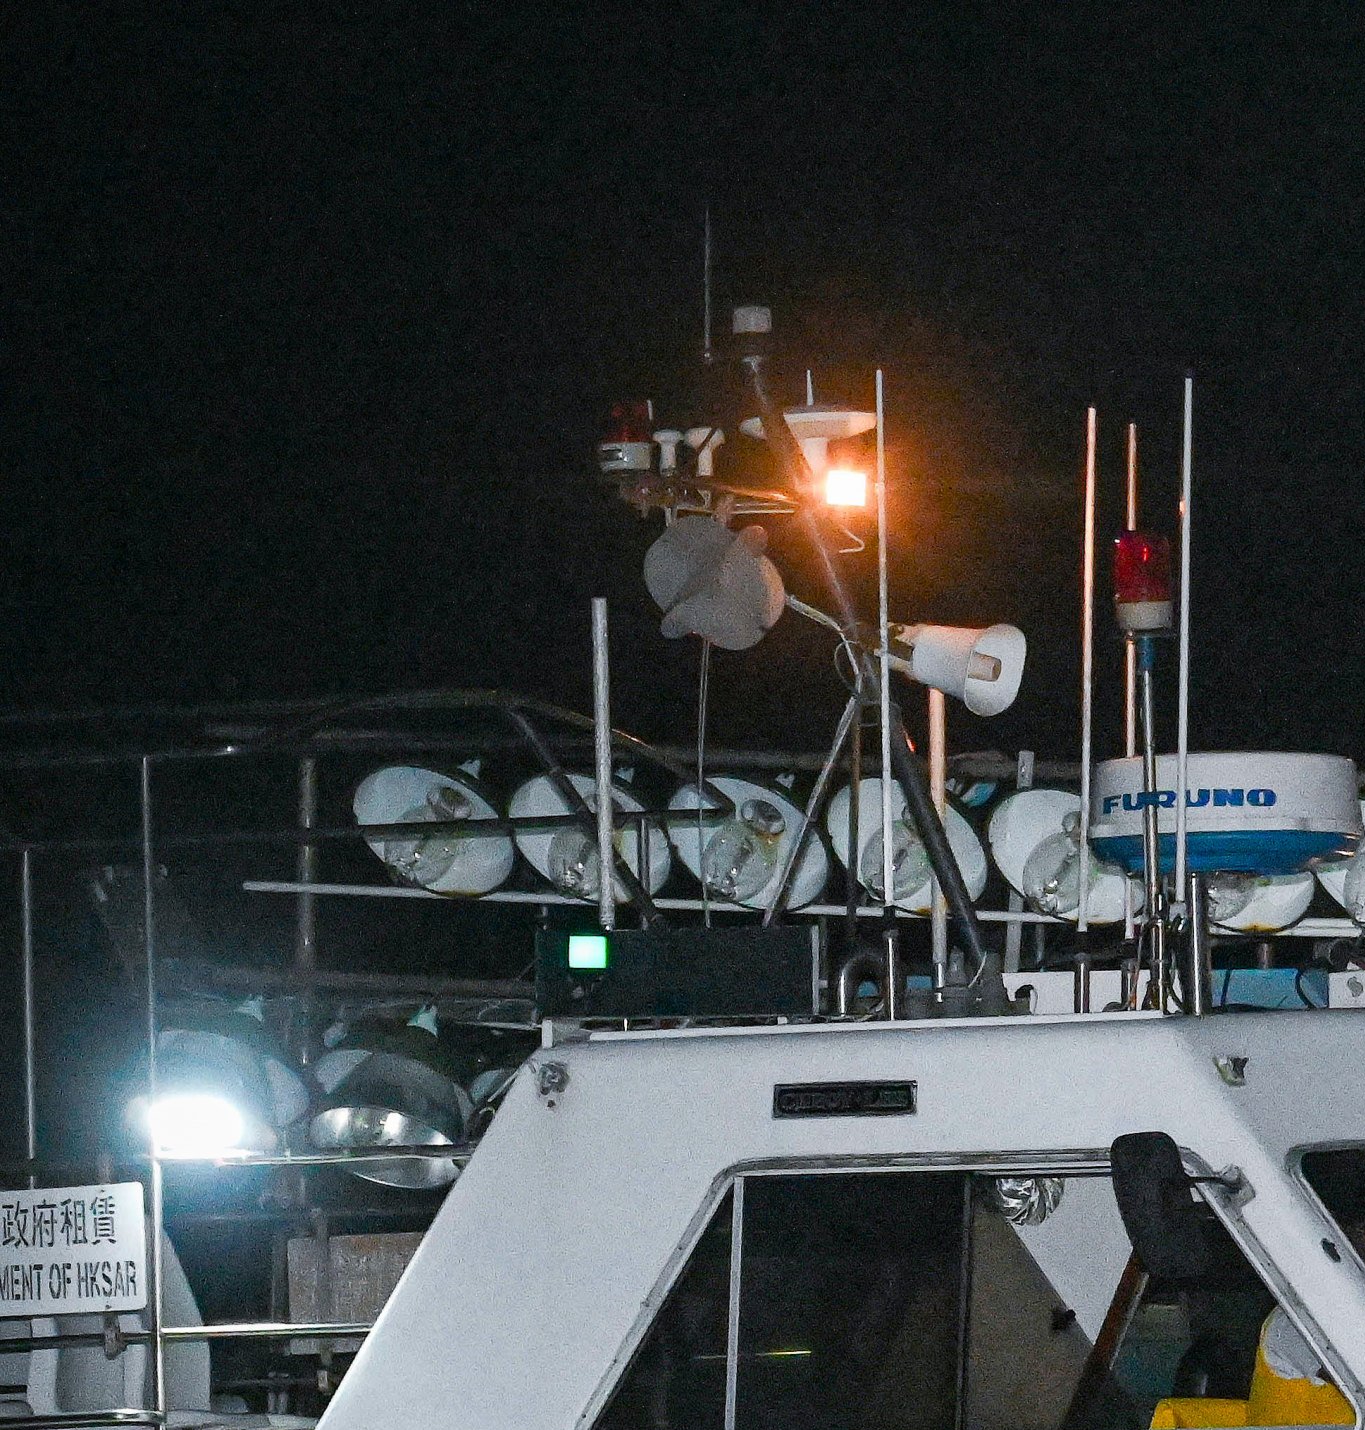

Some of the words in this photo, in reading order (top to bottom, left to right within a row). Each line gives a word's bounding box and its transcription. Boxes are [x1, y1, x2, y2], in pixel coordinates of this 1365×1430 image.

[1103, 788, 1277, 814] FURUNO
[2, 1196, 116, 1248] 政府租賃
[49, 1263, 72, 1299] OF
[77, 1260, 137, 1298] HKSAR
